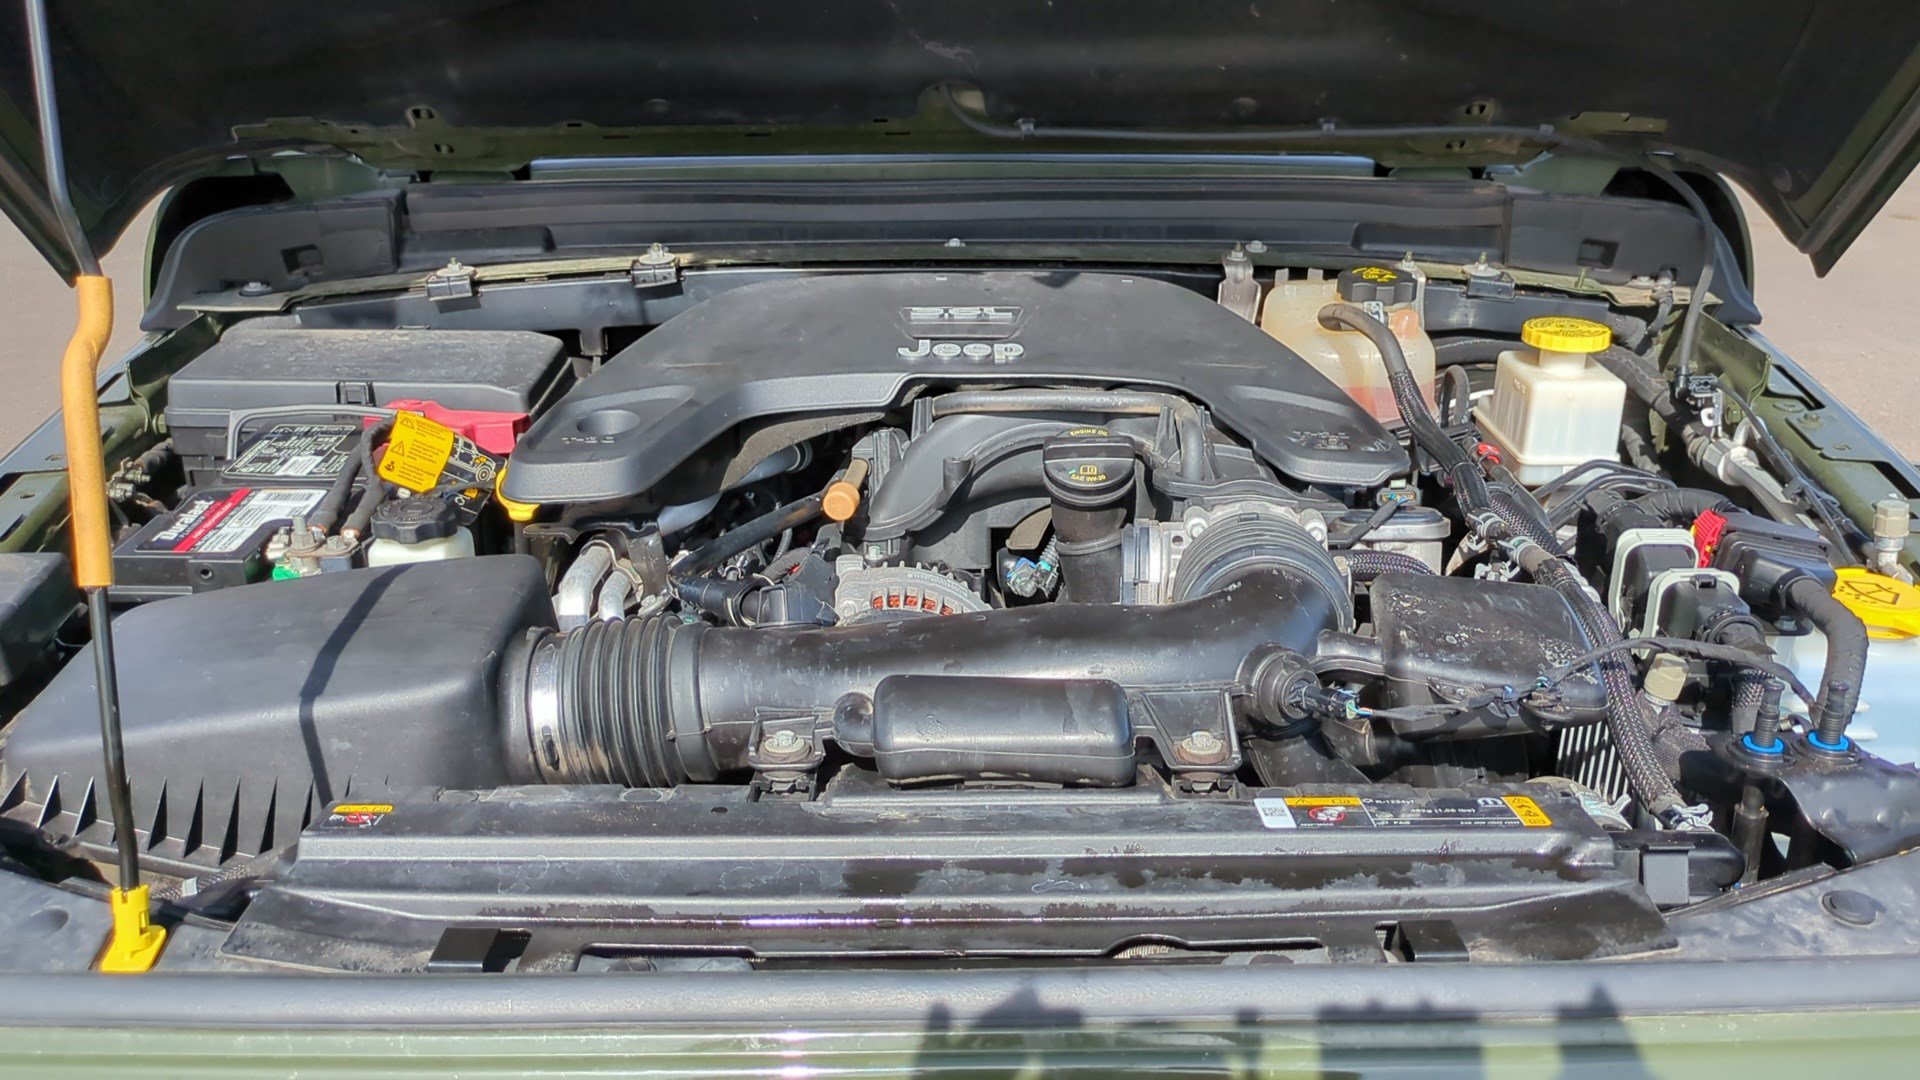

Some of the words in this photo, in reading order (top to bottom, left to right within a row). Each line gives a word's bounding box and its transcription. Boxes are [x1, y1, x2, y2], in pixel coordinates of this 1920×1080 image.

[897, 339, 1024, 364] Jeep
[1069, 428, 1097, 437] ENGINE
[1070, 474, 1085, 482] SAE
[151, 499, 216, 542] Duralast
